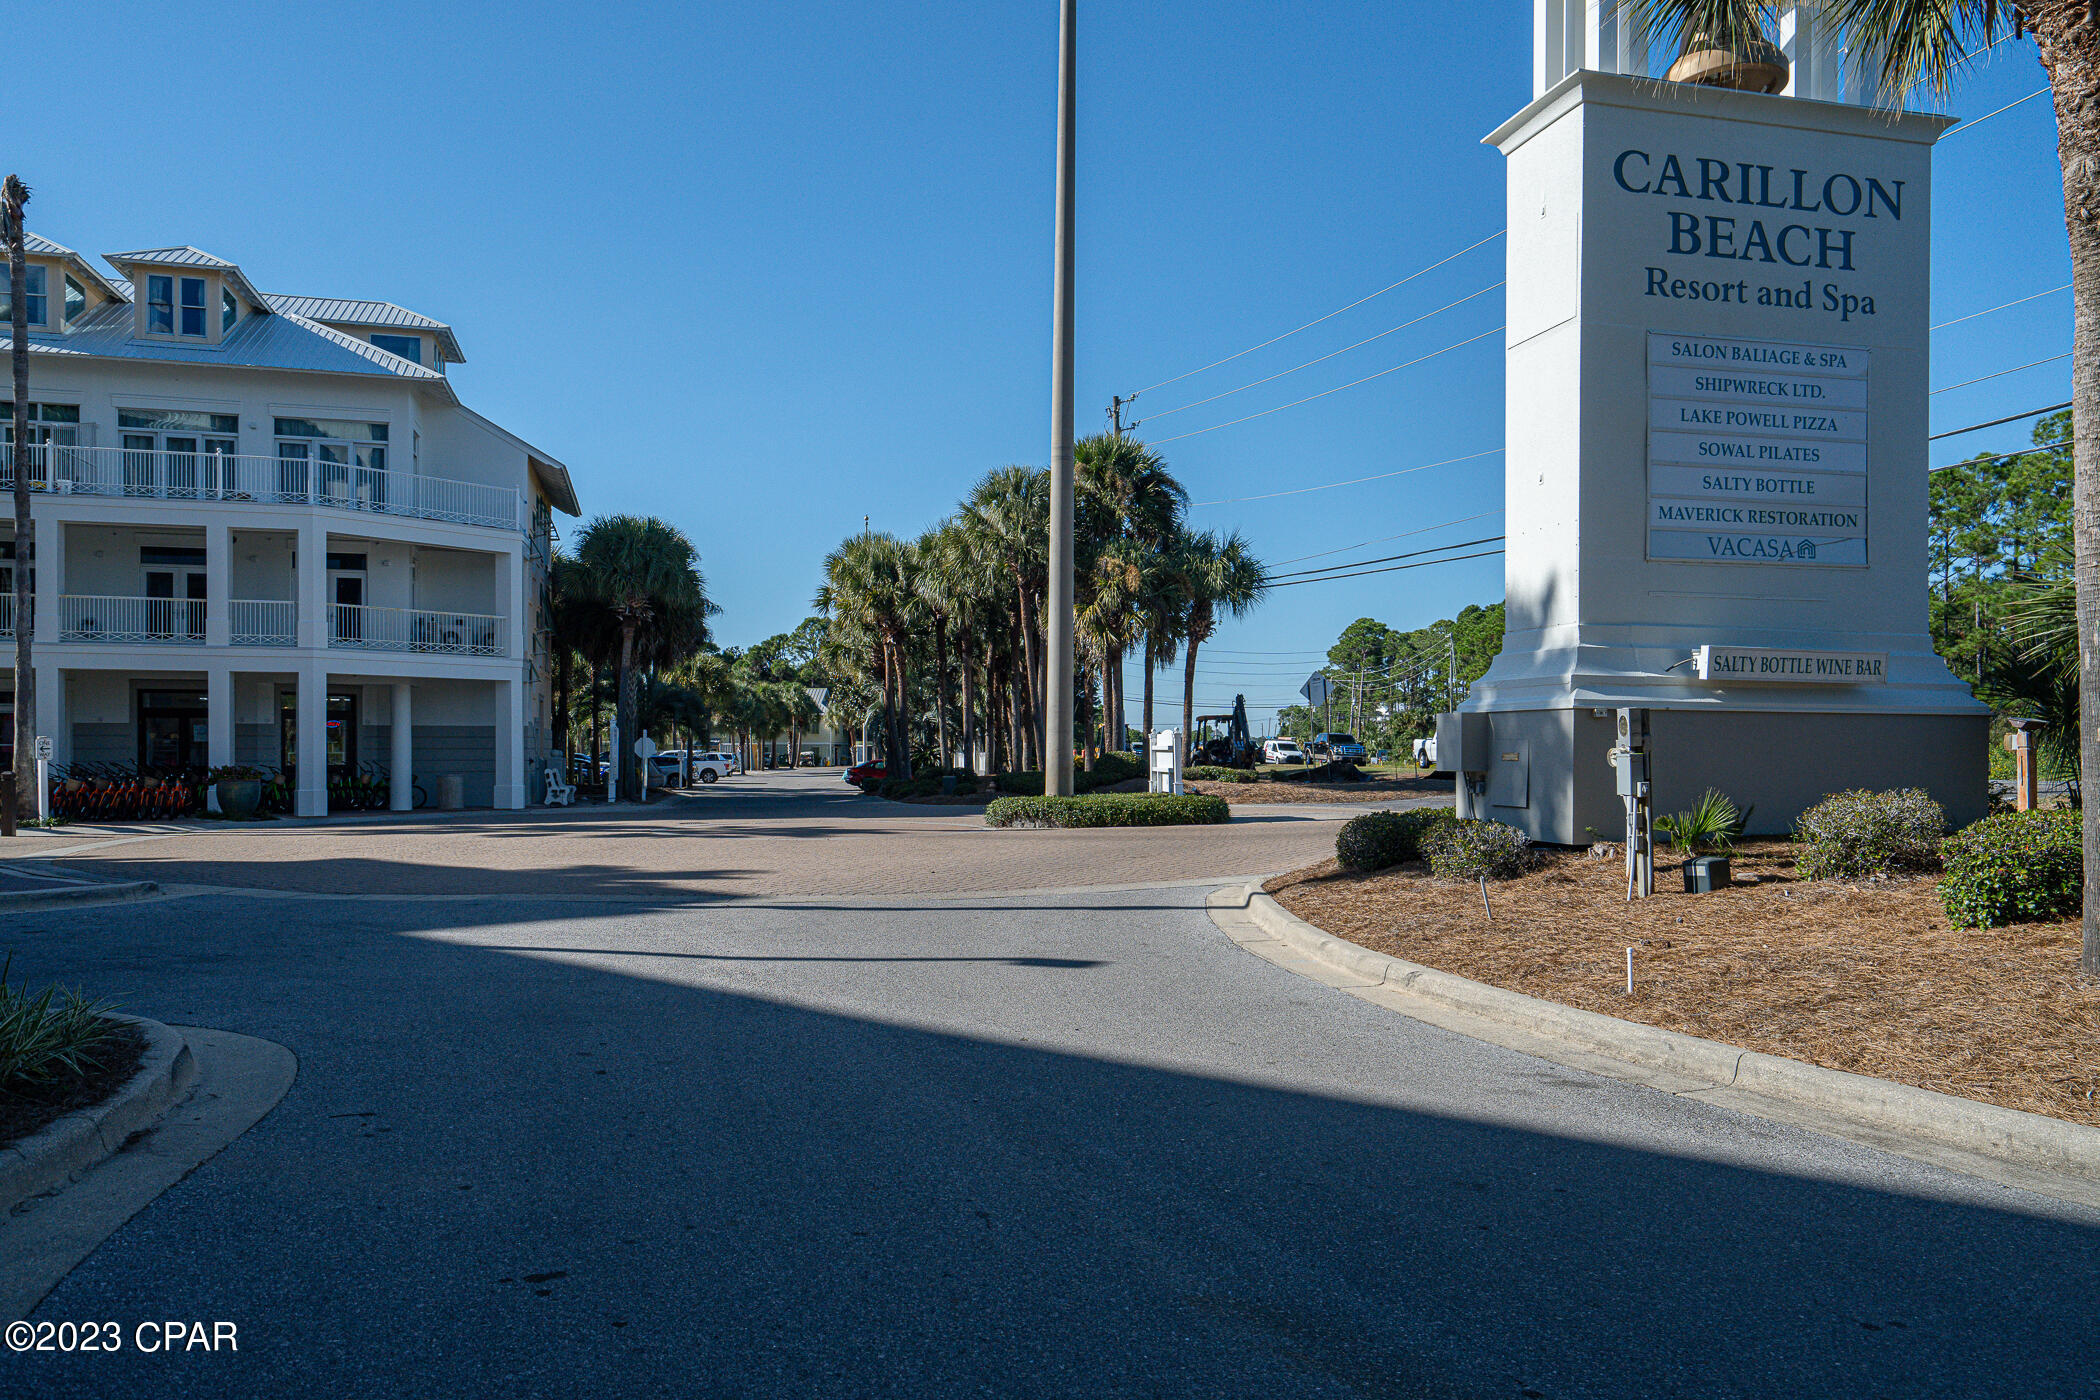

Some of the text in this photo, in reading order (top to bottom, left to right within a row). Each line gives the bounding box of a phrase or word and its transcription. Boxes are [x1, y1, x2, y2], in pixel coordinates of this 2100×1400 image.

[1612, 149, 1906, 221] CARILLON
[1666, 211, 1856, 271] BEACH
[1644, 266, 1876, 322] Resort and Spa
[1671, 341, 1847, 368] SALON BALIAGE & SPA
[1695, 376, 1826, 399] SHIPWRECK LTD.
[1680, 408, 1838, 432] LAKE POWELL PIZZA
[1698, 441, 1820, 462] SOWAL PILATES
[1702, 475, 1815, 494] SALTY BOTTLE
[1658, 505, 1858, 528] MAVERICK RESTORATION
[1707, 536, 1795, 559] VACASA
[1713, 655, 1882, 676] SALTY BOTTLE WINE BAR
